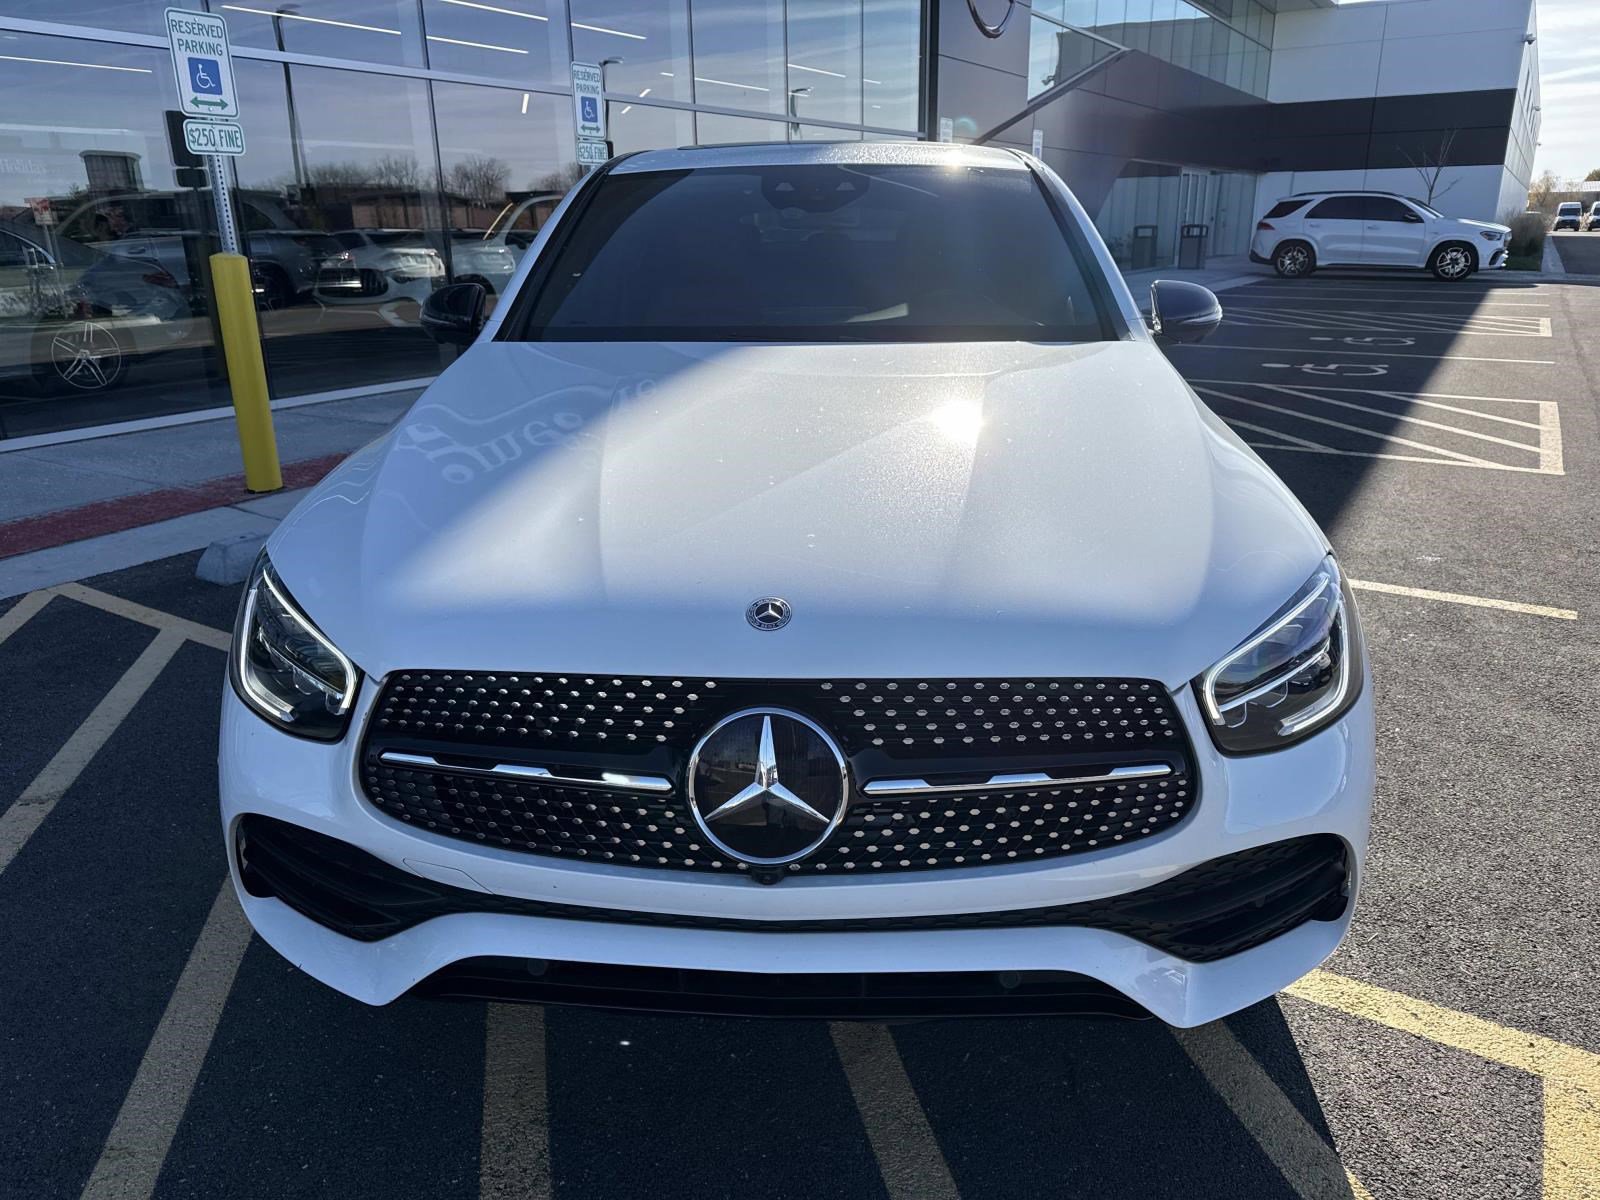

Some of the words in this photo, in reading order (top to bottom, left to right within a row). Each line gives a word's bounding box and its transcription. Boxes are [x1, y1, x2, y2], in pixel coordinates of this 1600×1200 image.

[171, 19, 223, 39] RESERVED
[177, 39, 223, 56] PARKING
[573, 70, 600, 83] RESERVED
[576, 83, 600, 95] PARKING
[189, 128, 215, 147] $250
[219, 129, 242, 148] FINE
[579, 145, 594, 160] $250
[594, 146, 608, 160] FINE
